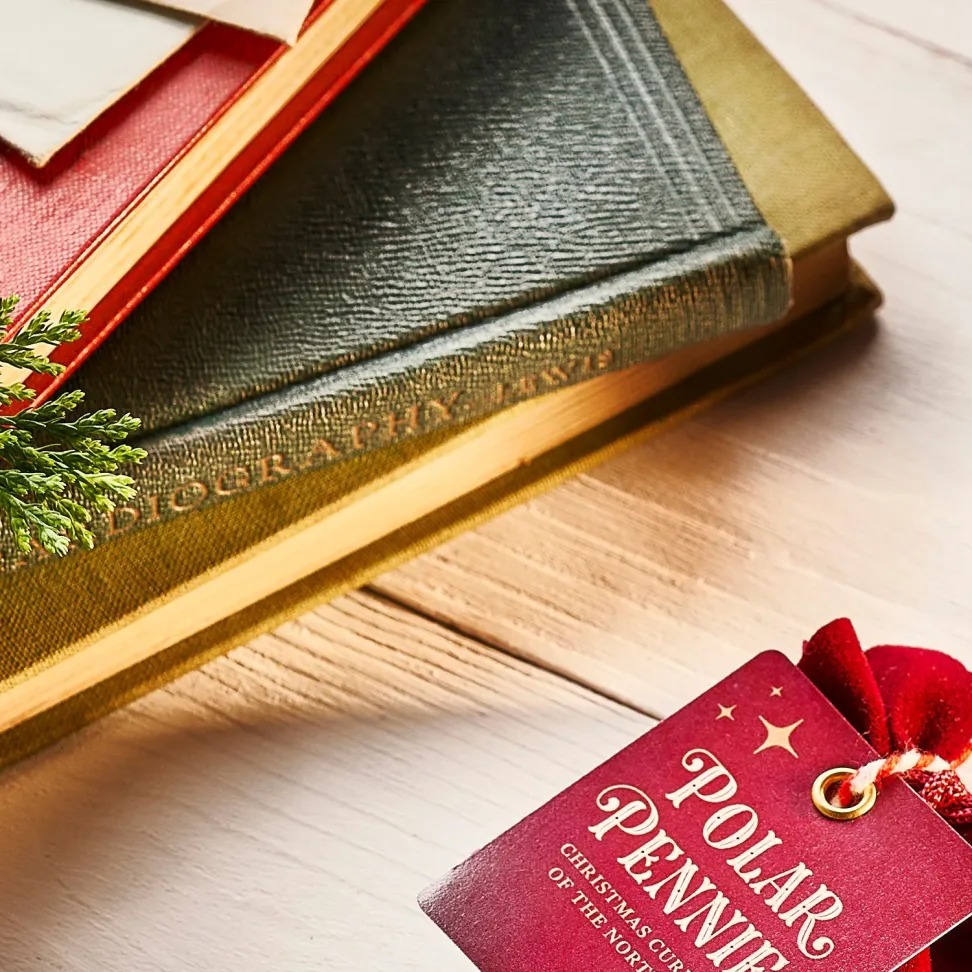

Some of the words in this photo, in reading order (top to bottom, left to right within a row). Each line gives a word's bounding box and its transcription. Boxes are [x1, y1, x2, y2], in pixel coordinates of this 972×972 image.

[548, 866, 573, 894] OF
[570, 888, 607, 930] THE
[560, 842, 651, 939] CHRISTMAS
[665, 748, 844, 959] POLAR
